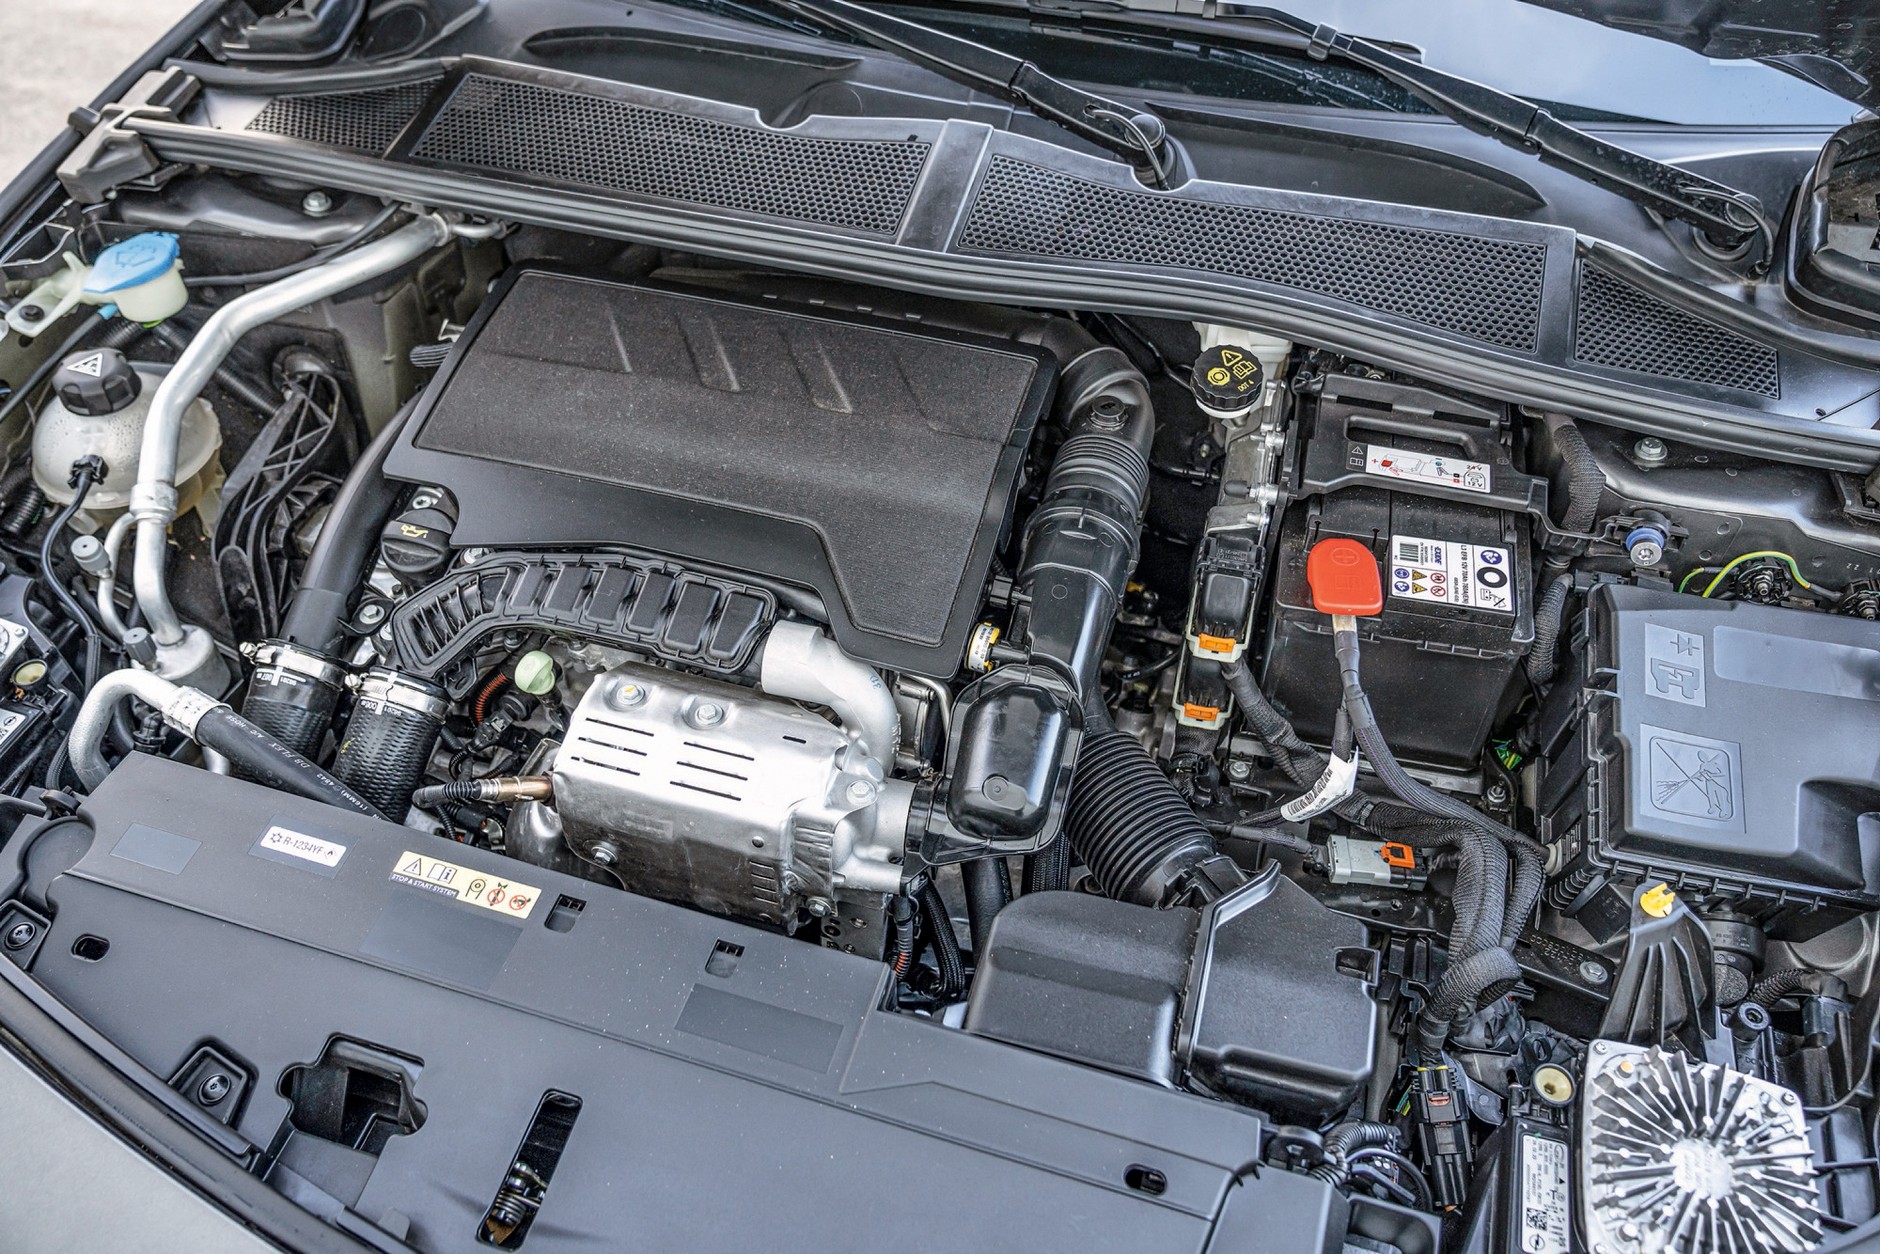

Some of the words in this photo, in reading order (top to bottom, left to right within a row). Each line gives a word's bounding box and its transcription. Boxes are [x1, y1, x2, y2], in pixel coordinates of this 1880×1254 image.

[1237, 382, 1249, 392] DOT
[225, 714, 247, 728] HOSE
[250, 729, 265, 738] A/C
[268, 742, 296, 758] FLEX
[283, 837, 324, 854] R-1234YF
[391, 874, 409, 883] STOP
[413, 880, 433, 890] START
[433, 885, 458, 897] SYSTEM
